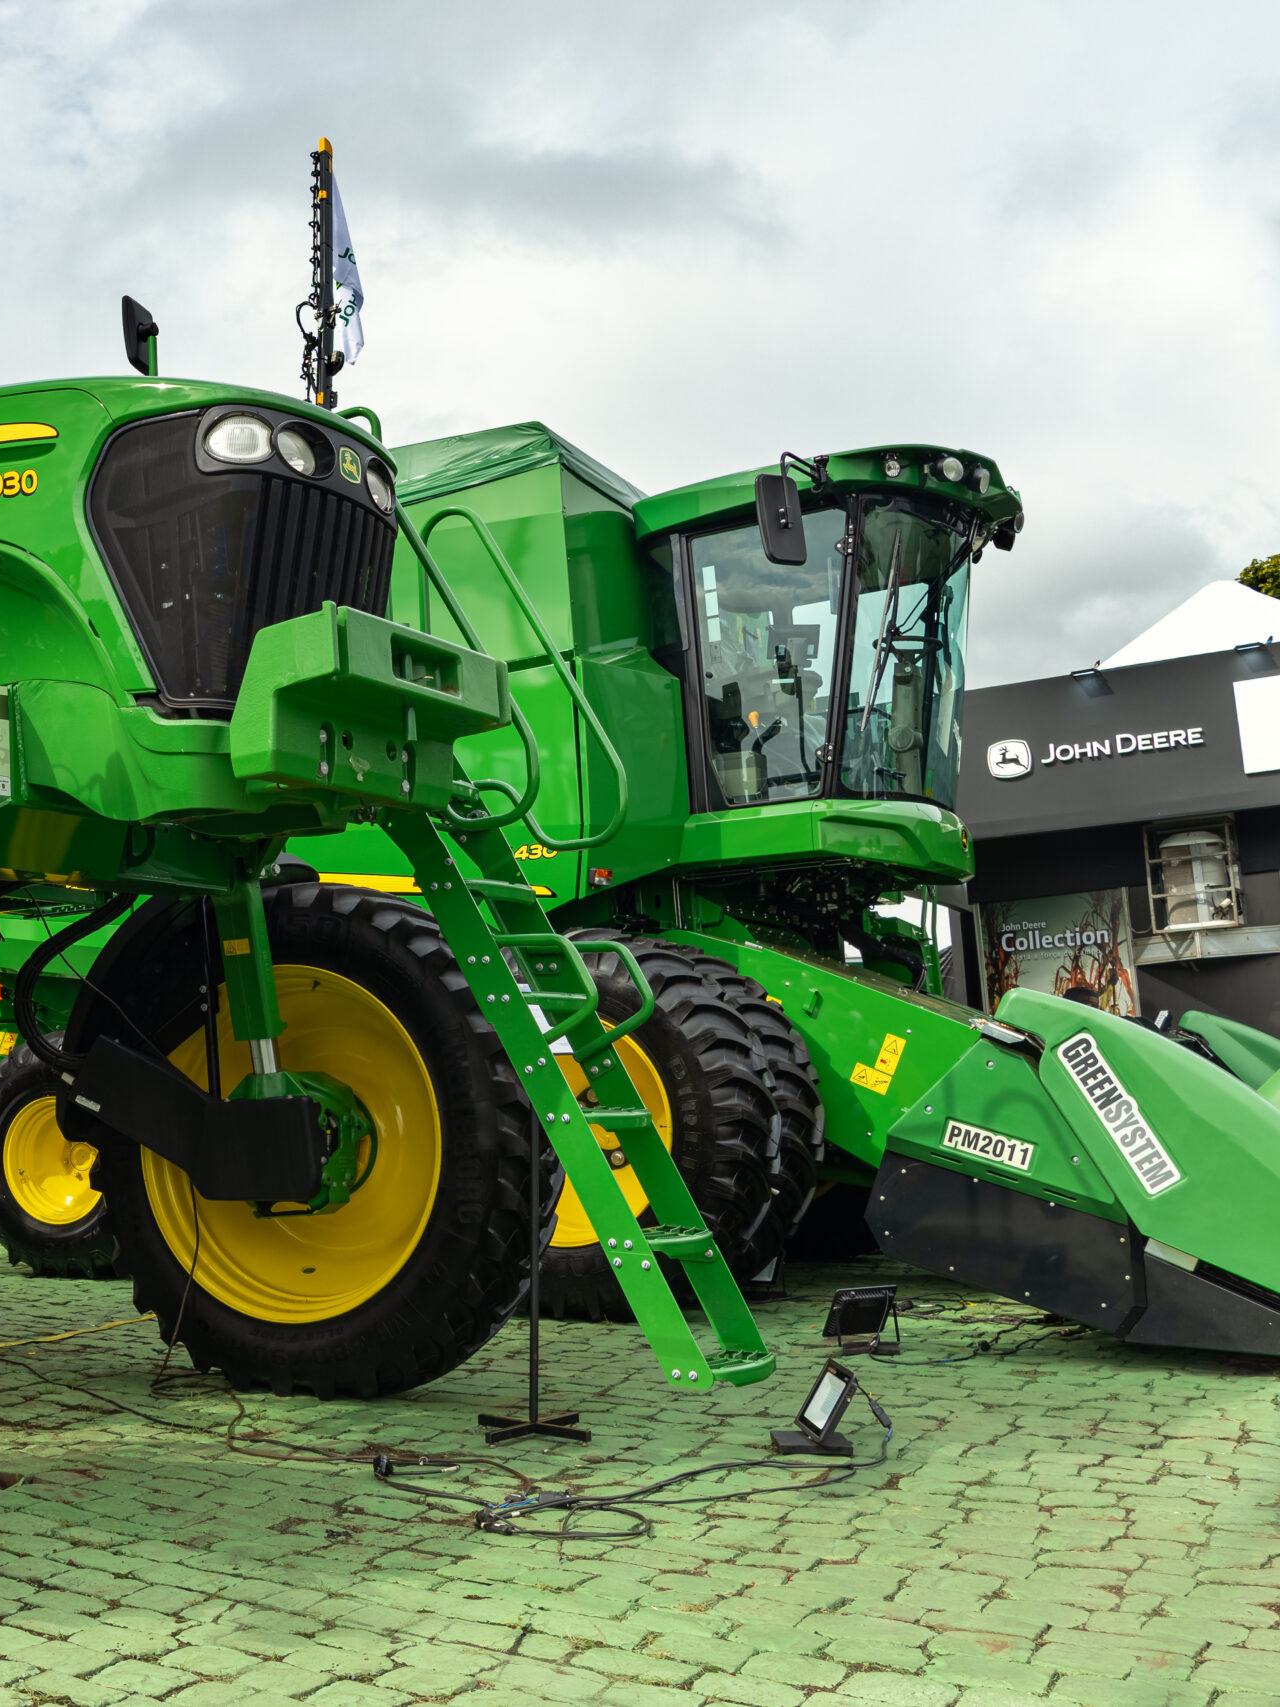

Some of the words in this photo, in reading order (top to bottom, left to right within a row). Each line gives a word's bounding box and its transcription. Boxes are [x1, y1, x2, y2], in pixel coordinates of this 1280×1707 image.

[1041, 739, 1111, 765] JOHN
[1115, 727, 1204, 754] DEERE
[1001, 923, 1021, 932] John
[1022, 921, 1047, 930] Deere
[1001, 927, 1109, 952] Collection
[1062, 1037, 1174, 1190] GREENSYSTEM
[947, 1124, 1030, 1166] PM2011
